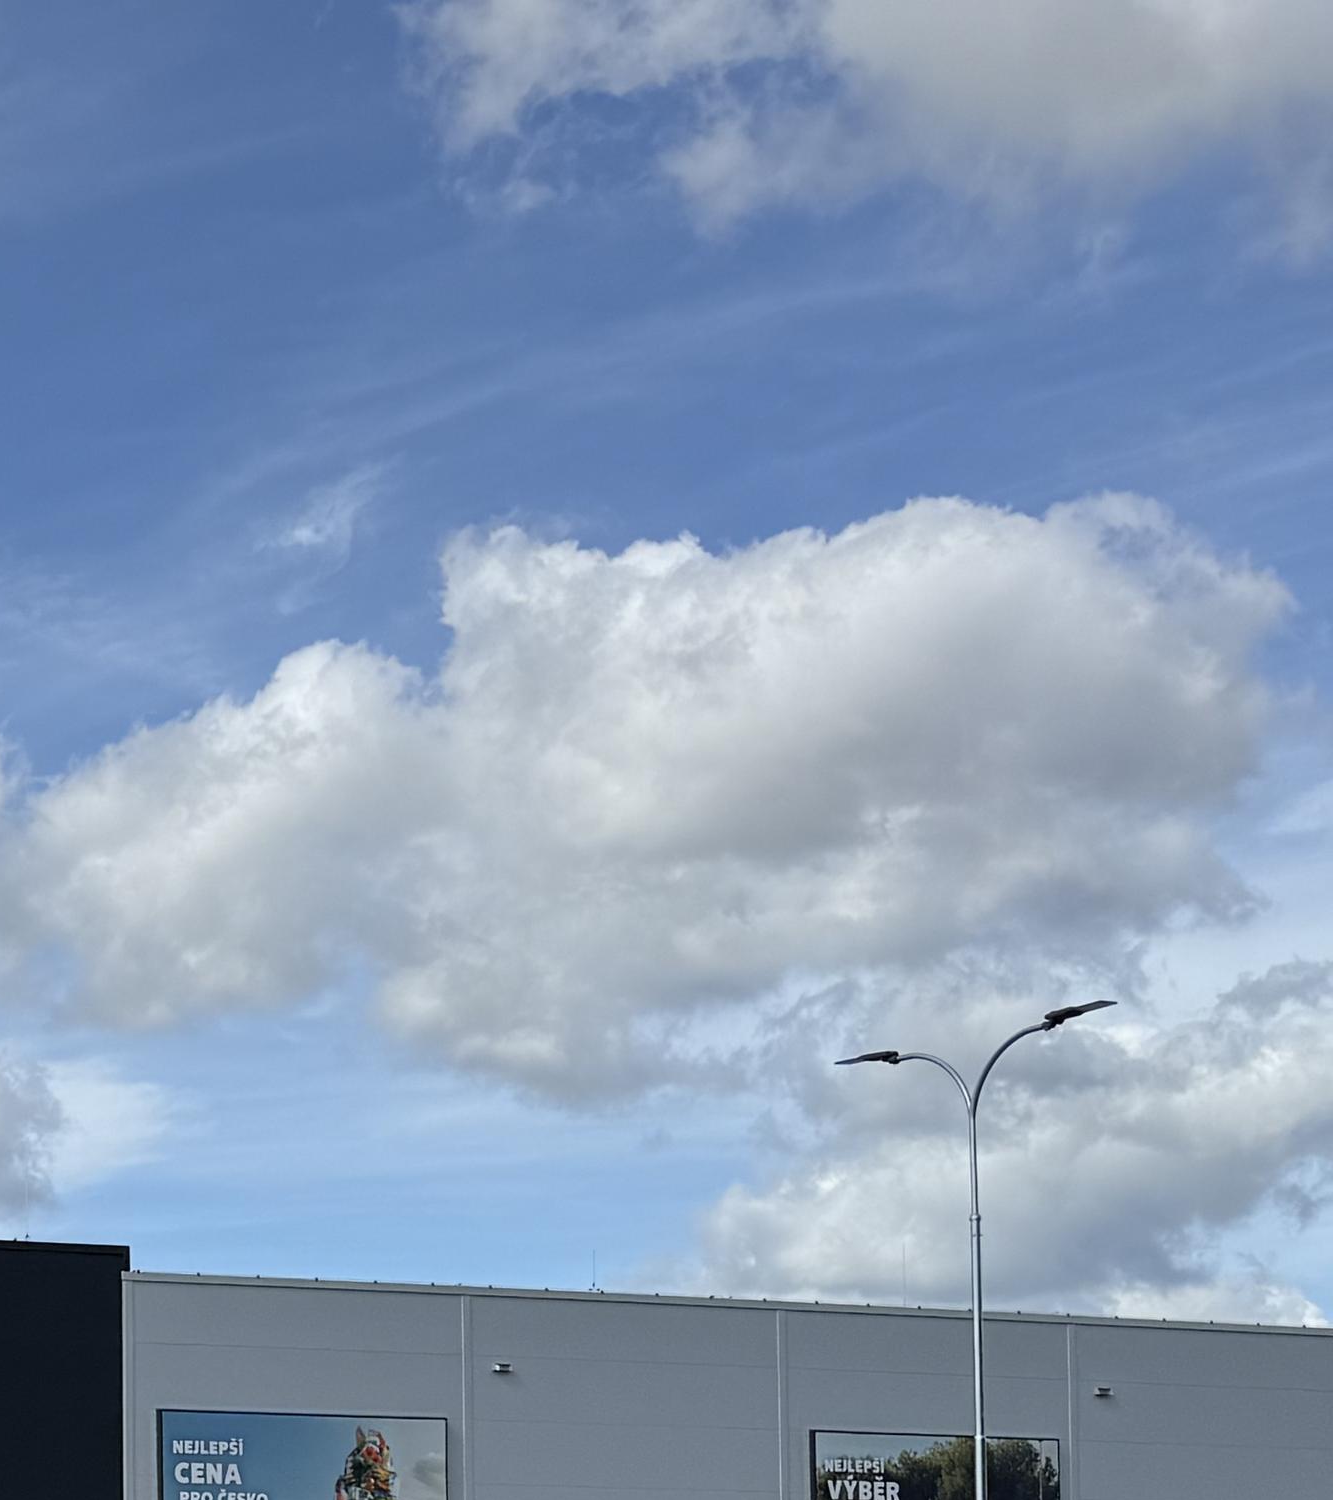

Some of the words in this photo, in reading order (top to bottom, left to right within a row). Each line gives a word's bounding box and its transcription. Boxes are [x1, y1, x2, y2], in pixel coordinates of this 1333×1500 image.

[172, 1438, 244, 1456] NEJLEPŠÍ
[174, 1462, 242, 1485] CENA
[824, 1457, 885, 1474] NEJLEPŠÍ
